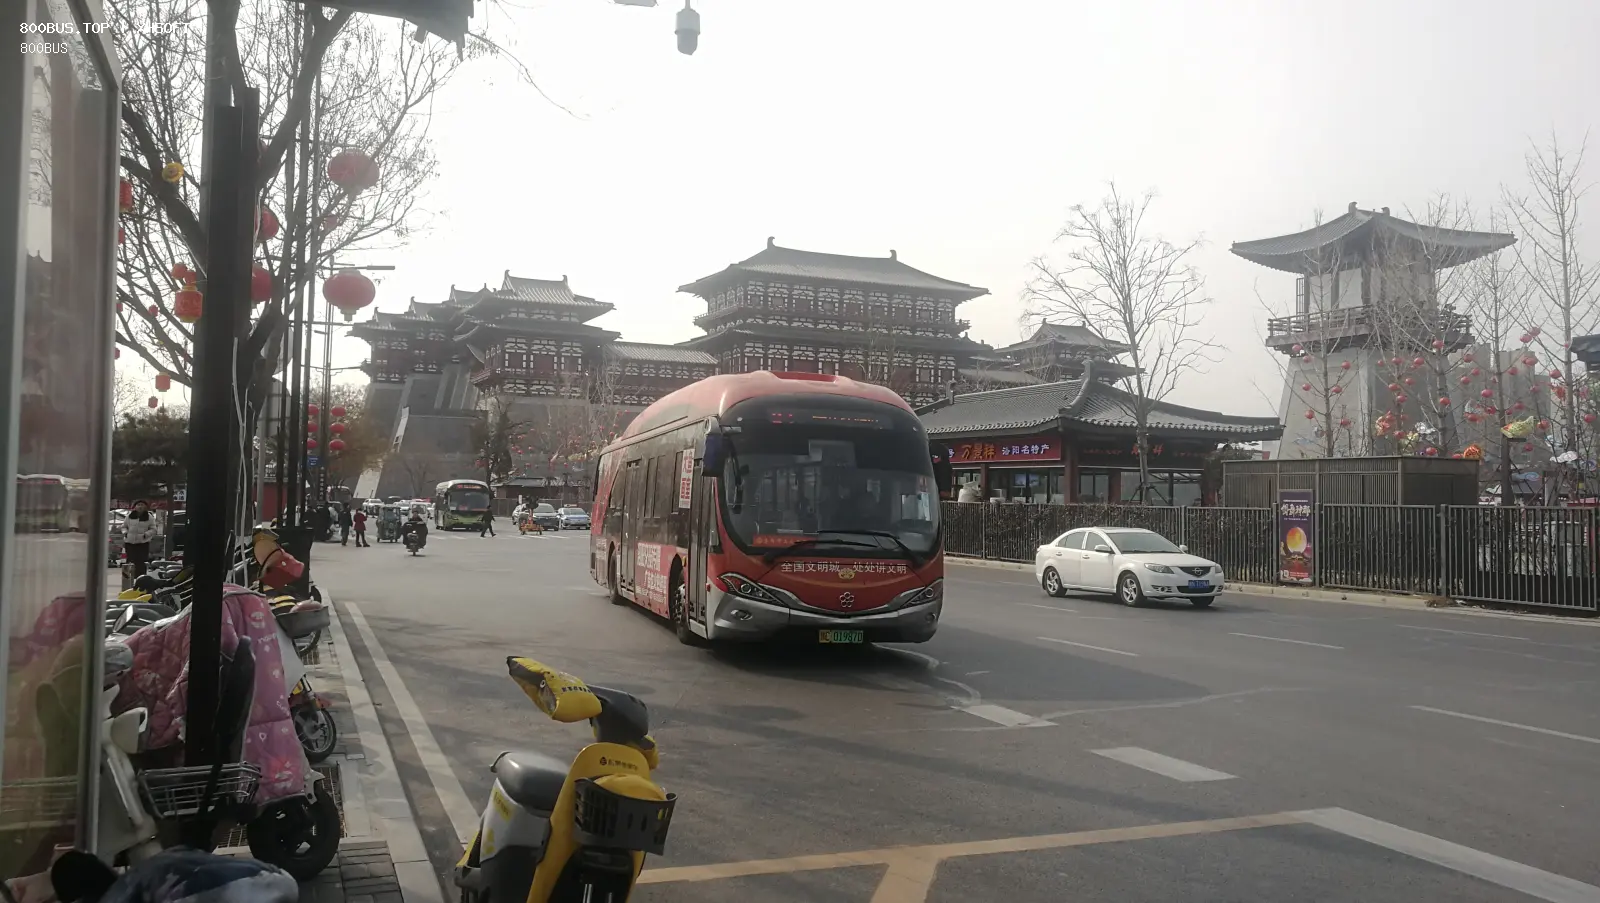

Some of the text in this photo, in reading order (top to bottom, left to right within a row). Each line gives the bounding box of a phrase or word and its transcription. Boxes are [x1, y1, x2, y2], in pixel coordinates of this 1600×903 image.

[1002, 444, 1050, 456] 洛阳名特产
[781, 561, 907, 574] 全国文明城 处处讲文明
